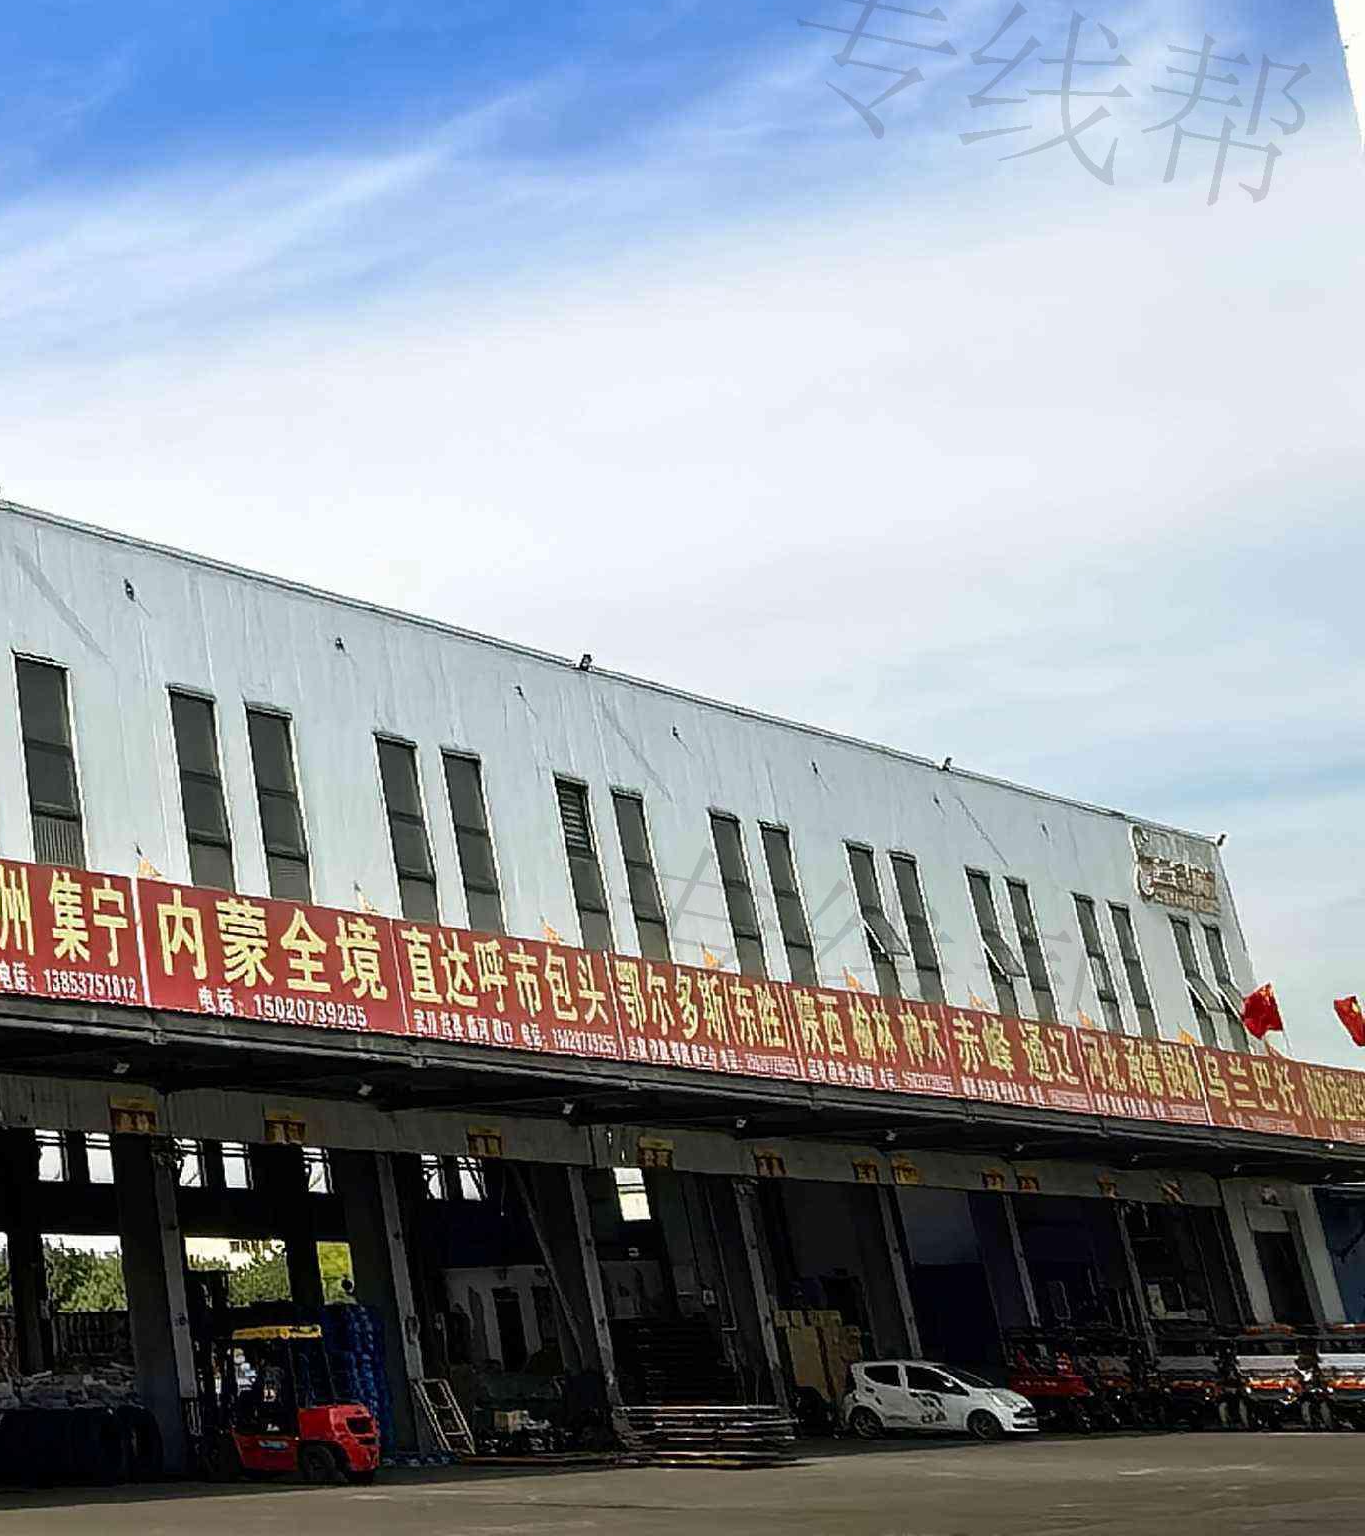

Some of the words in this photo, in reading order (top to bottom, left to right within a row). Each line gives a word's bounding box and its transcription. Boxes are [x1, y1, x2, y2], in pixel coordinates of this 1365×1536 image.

[49, 869, 129, 967] 集宁
[156, 888, 387, 1001] 内蒙全境
[400, 927, 609, 1025] 直达呼市包头
